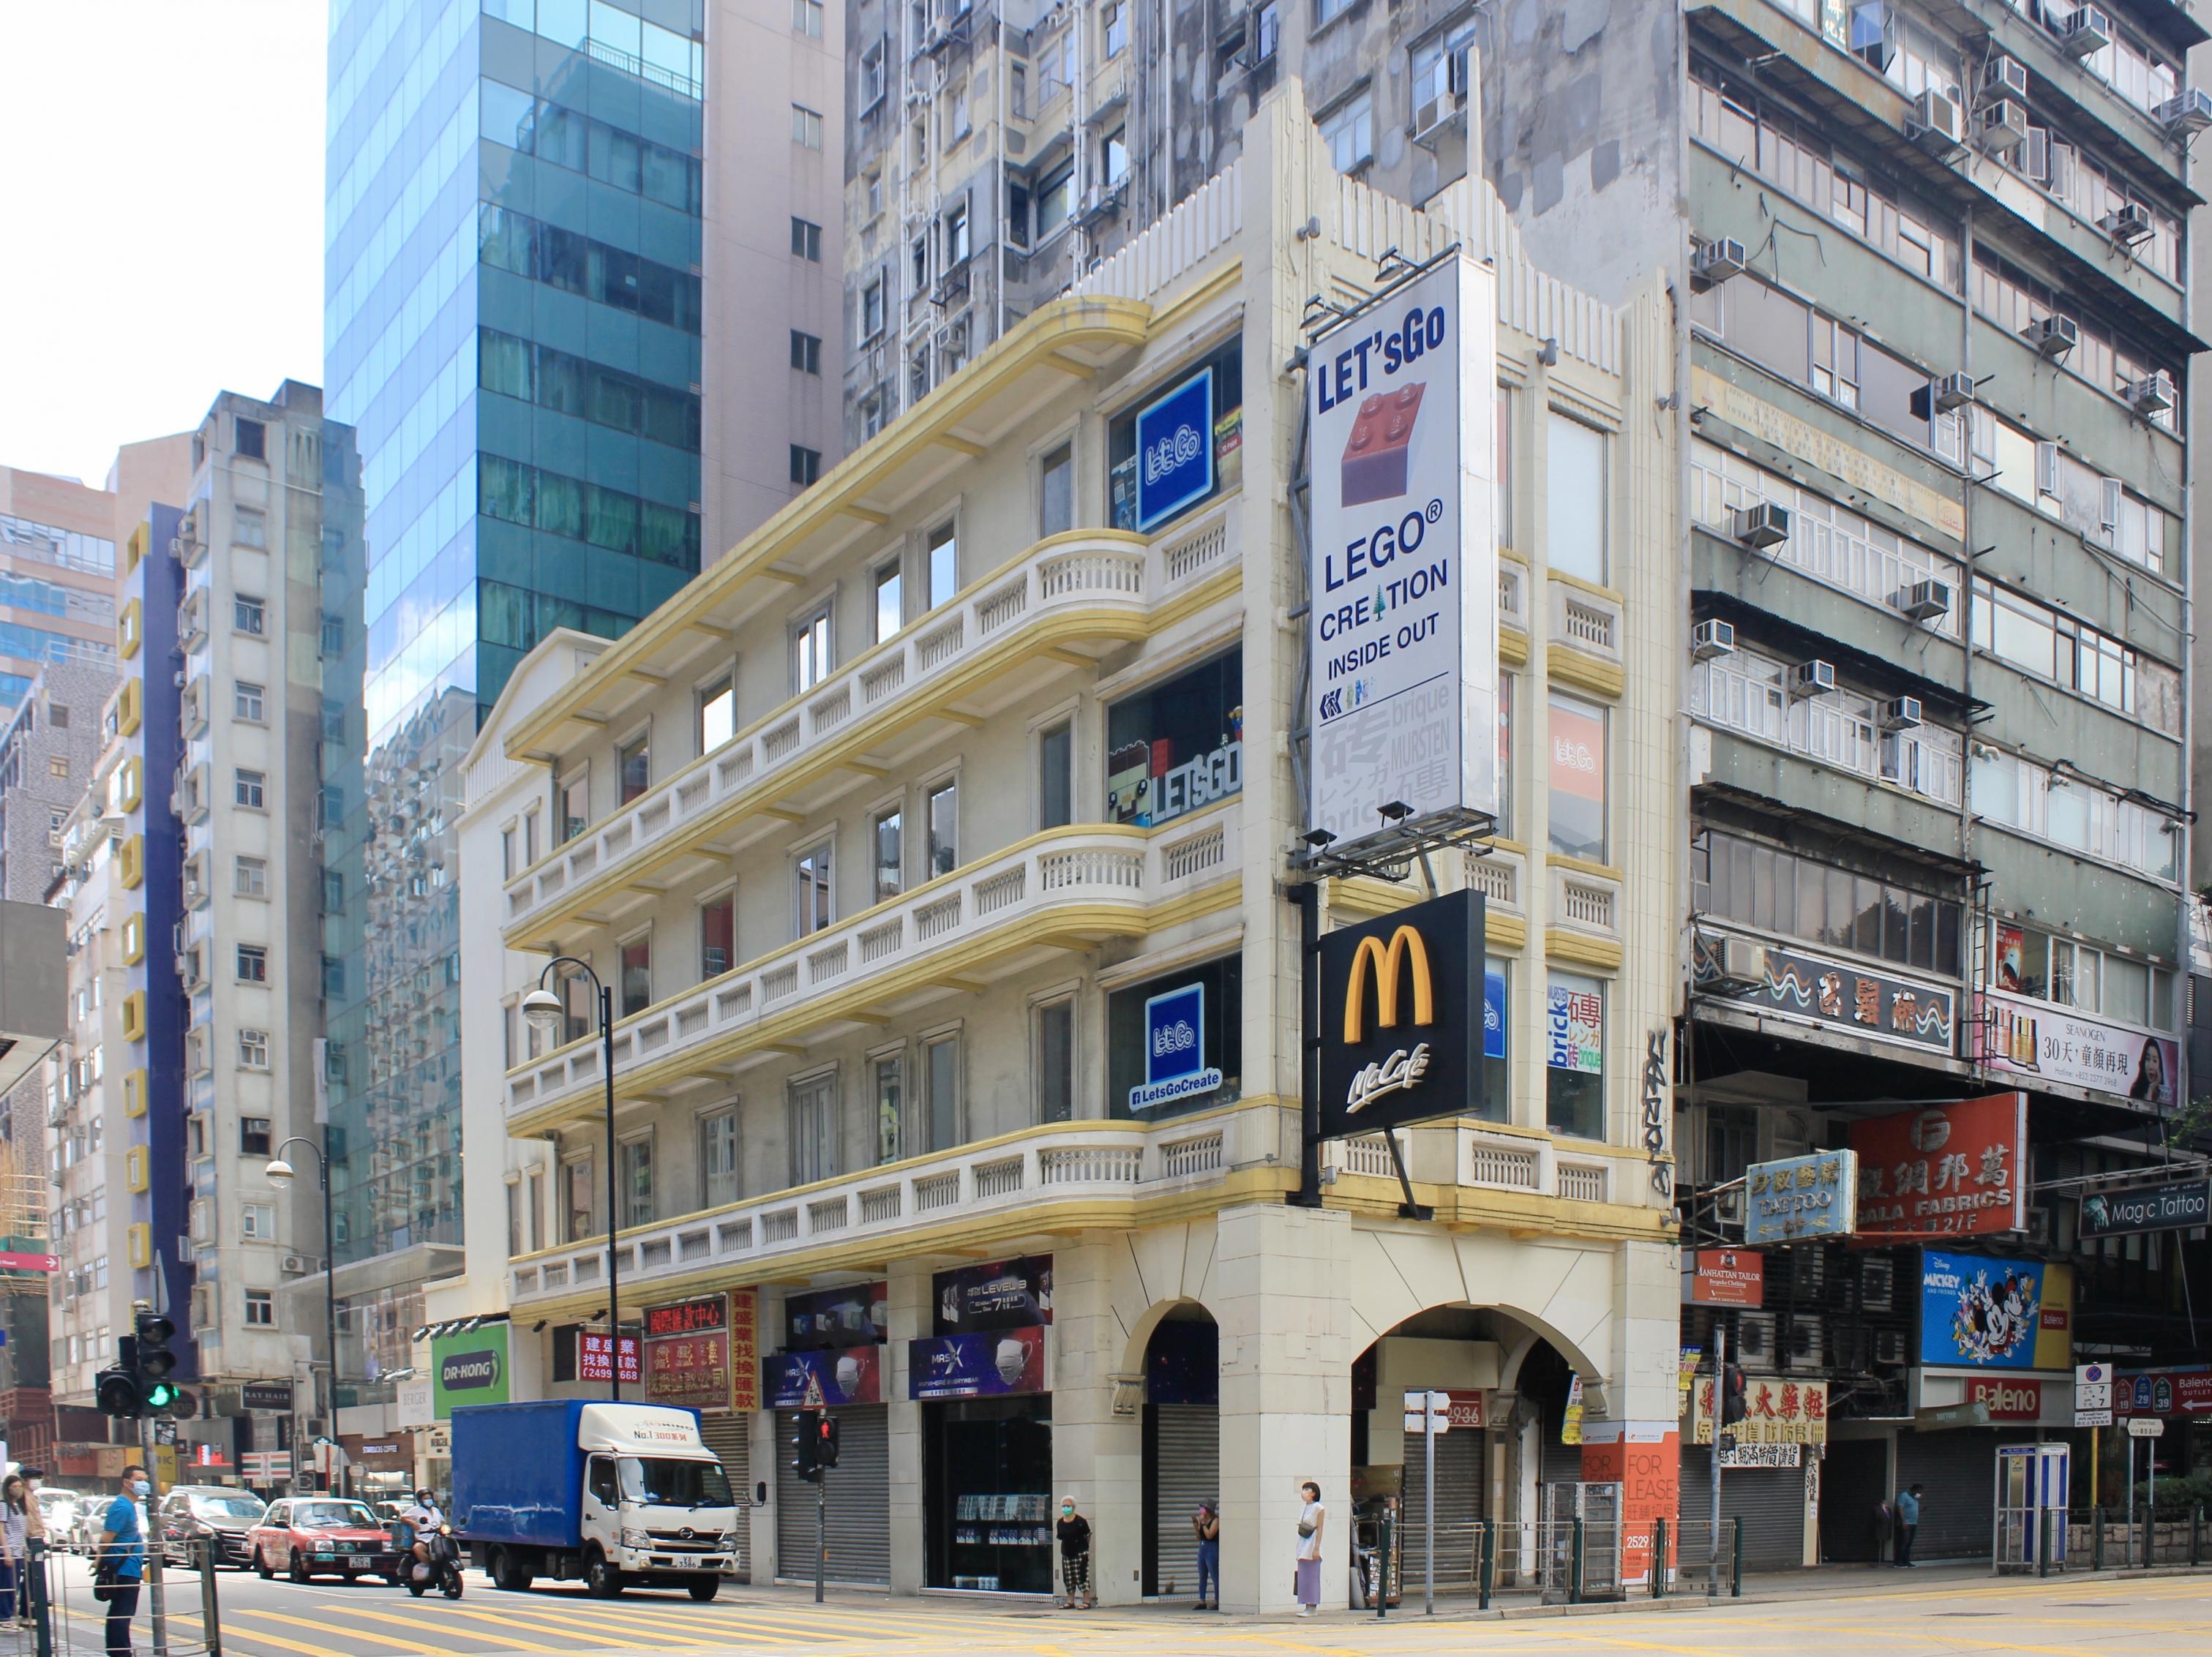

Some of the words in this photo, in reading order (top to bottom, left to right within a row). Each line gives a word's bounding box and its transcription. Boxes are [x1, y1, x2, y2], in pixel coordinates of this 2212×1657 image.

[1328, 634, 1391, 680] INSIDE
[1397, 612, 1439, 648] OUT
[1392, 685, 1450, 728] brique
[1391, 718, 1450, 772] MURSTEN
[1548, 1002, 1567, 1067] brick
[2066, 1024, 2105, 1042] SEANOGEN
[1347, 1042, 1430, 1105] McCafé
[1142, 1073, 1219, 1102] LetsGoCreate
[1758, 1190, 1832, 1215] TATTOO
[1915, 1189, 2012, 1217] FABRICS
[2160, 1195, 2205, 1215] Tattoo
[1943, 1214, 1977, 1232] 2/F
[1738, 1272, 1761, 1281] TAILOR
[1923, 1273, 1960, 1288] MICKEY
[982, 1282, 1016, 1294] LEVEL
[1019, 1280, 1027, 1289] 3
[2044, 1315, 2063, 1325] Baleno
[618, 1370, 637, 1380] 668
[1976, 1381, 2036, 1411] Baleno
[2099, 1386, 2104, 1394] 7
[363, 1445, 383, 1454] STARBUCKS
[1583, 1456, 1611, 1472] FOR
[1628, 1455, 1662, 1475] FOR
[1627, 1479, 1674, 1500] LEASE
[1627, 1536, 1649, 1549] 2529
